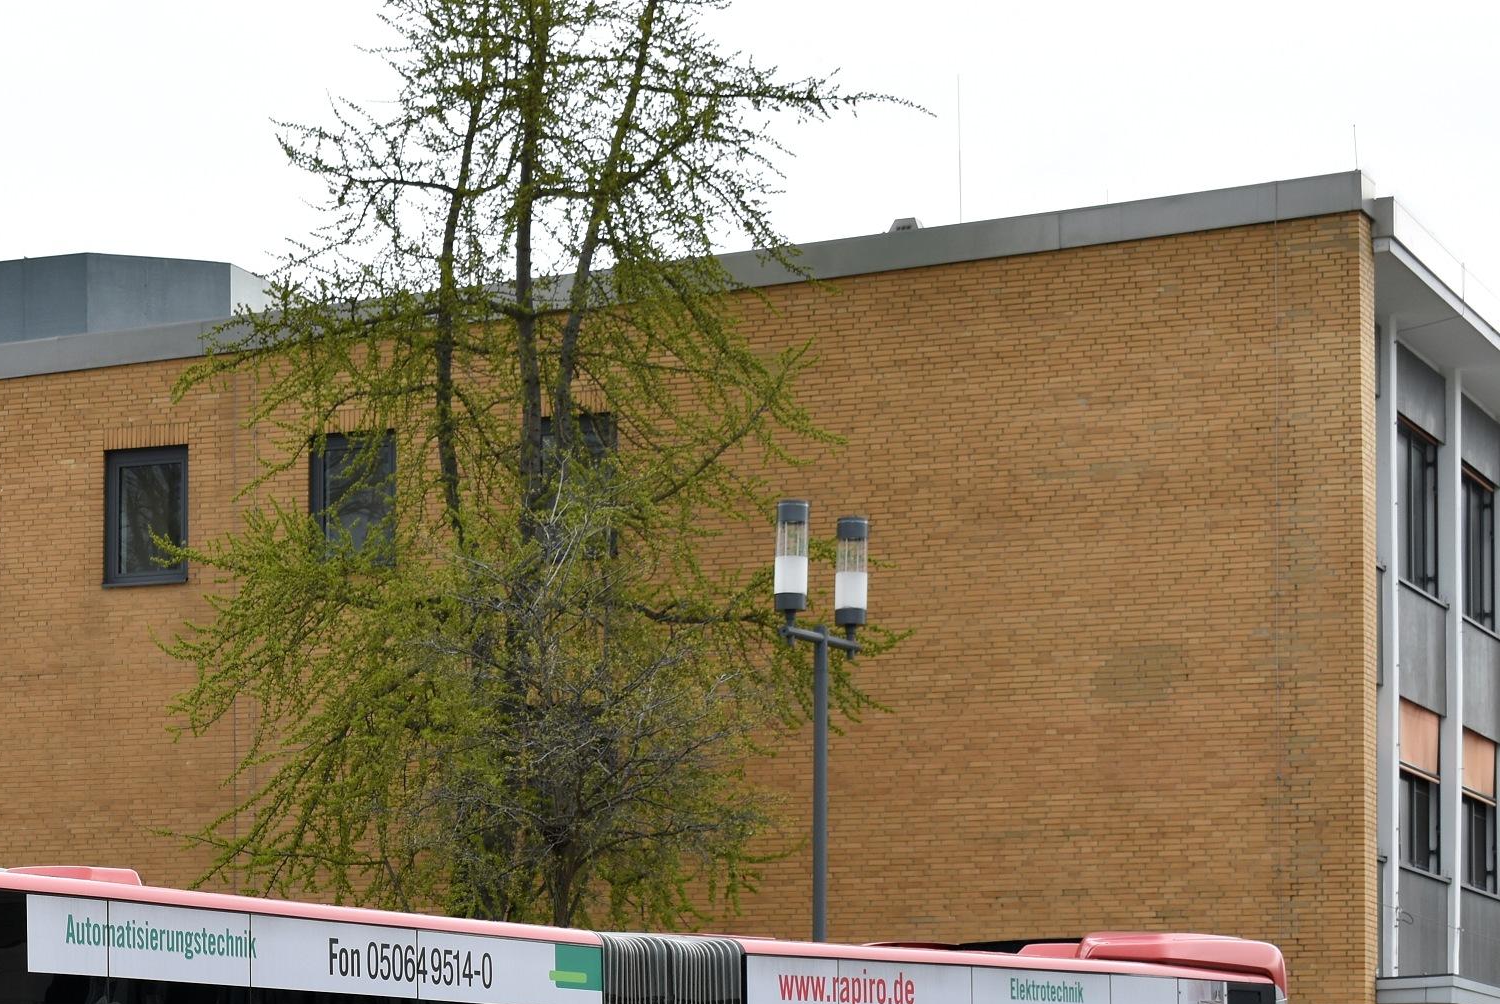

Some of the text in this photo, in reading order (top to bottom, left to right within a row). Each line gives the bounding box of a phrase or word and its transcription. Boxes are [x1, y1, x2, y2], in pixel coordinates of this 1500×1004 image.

[65, 914, 257, 960] Automatisierungstechnik
[329, 938, 360, 978] Fon
[1010, 978, 1084, 1003] Elektrotechnik
